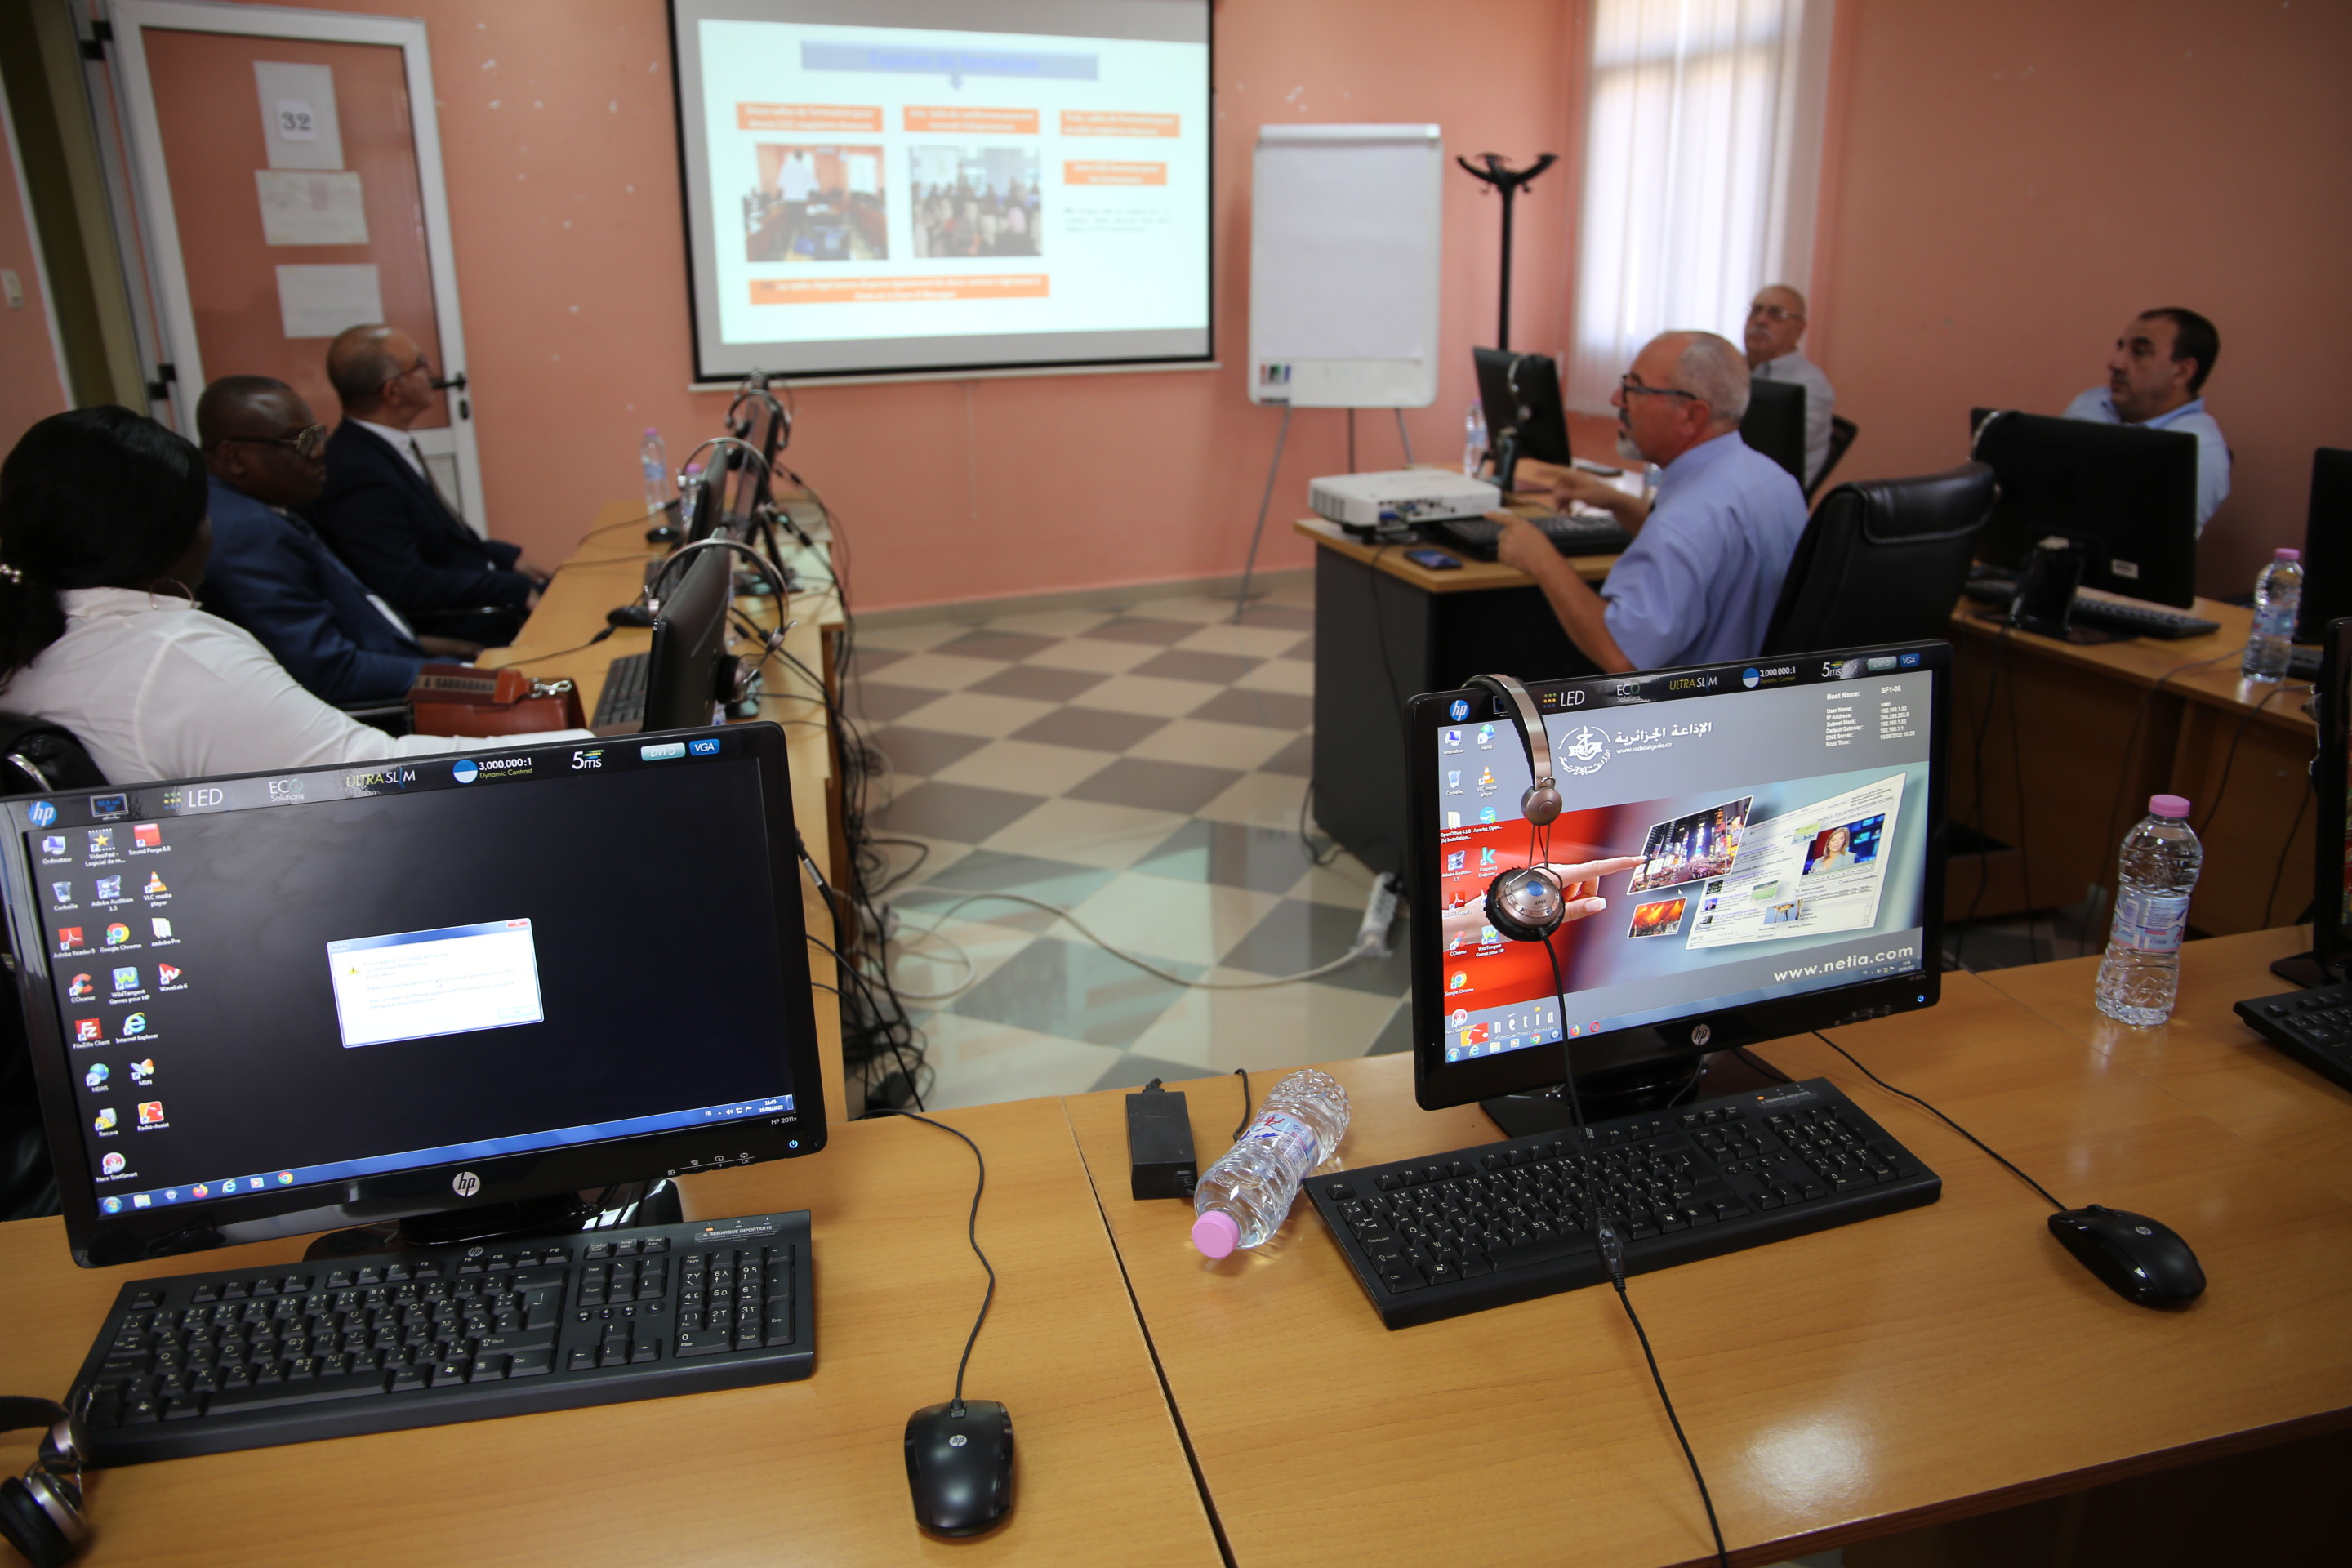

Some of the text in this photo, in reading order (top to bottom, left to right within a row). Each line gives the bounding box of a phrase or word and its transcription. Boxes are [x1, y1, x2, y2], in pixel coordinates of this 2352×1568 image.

[281, 111, 311, 131] 32
[1902, 657, 1916, 665] VGA
[1617, 683, 1641, 696] ECO
[1669, 679, 1696, 692] ULTRA
[1881, 685, 1902, 694] SF1-06
[1560, 690, 1585, 707] LED
[1617, 695, 1641, 703] Solutions
[1451, 700, 1468, 721] hp
[1615, 722, 1712, 746] الإذاعة الجزائرية
[650, 746, 676, 757] DVI-D
[694, 743, 715, 753] VGA
[1616, 742, 1673, 754] www.radioalgerie.dz
[479, 757, 532, 773] 3,000,000:1
[572, 751, 602, 769] 5ms
[479, 767, 533, 779] Dynamic Contrast
[269, 779, 303, 794] ECO
[346, 775, 384, 787] ULTRA
[189, 788, 223, 808] LED
[271, 792, 305, 802] Solutions
[30, 801, 55, 826] hp
[147, 846, 163, 855] Forge
[53, 903, 78, 911] Corbeille
[150, 900, 167, 908] player
[100, 945, 120, 953] Google
[1774, 947, 1913, 982] www.netia.com
[111, 989, 146, 997] WildTangent
[128, 995, 141, 1003] pour
[115, 1034, 159, 1044] Internet Explorer
[1693, 1024, 1709, 1045] hp
[73, 1041, 94, 1049] FileZilla
[137, 1122, 170, 1131] Radio-Assist
[110, 1172, 138, 1181] StartSmart
[455, 1171, 478, 1196] hp
[2136, 1227, 2150, 1235] hp
[468, 1247, 483, 1257] hp
[951, 1435, 965, 1446] hp
